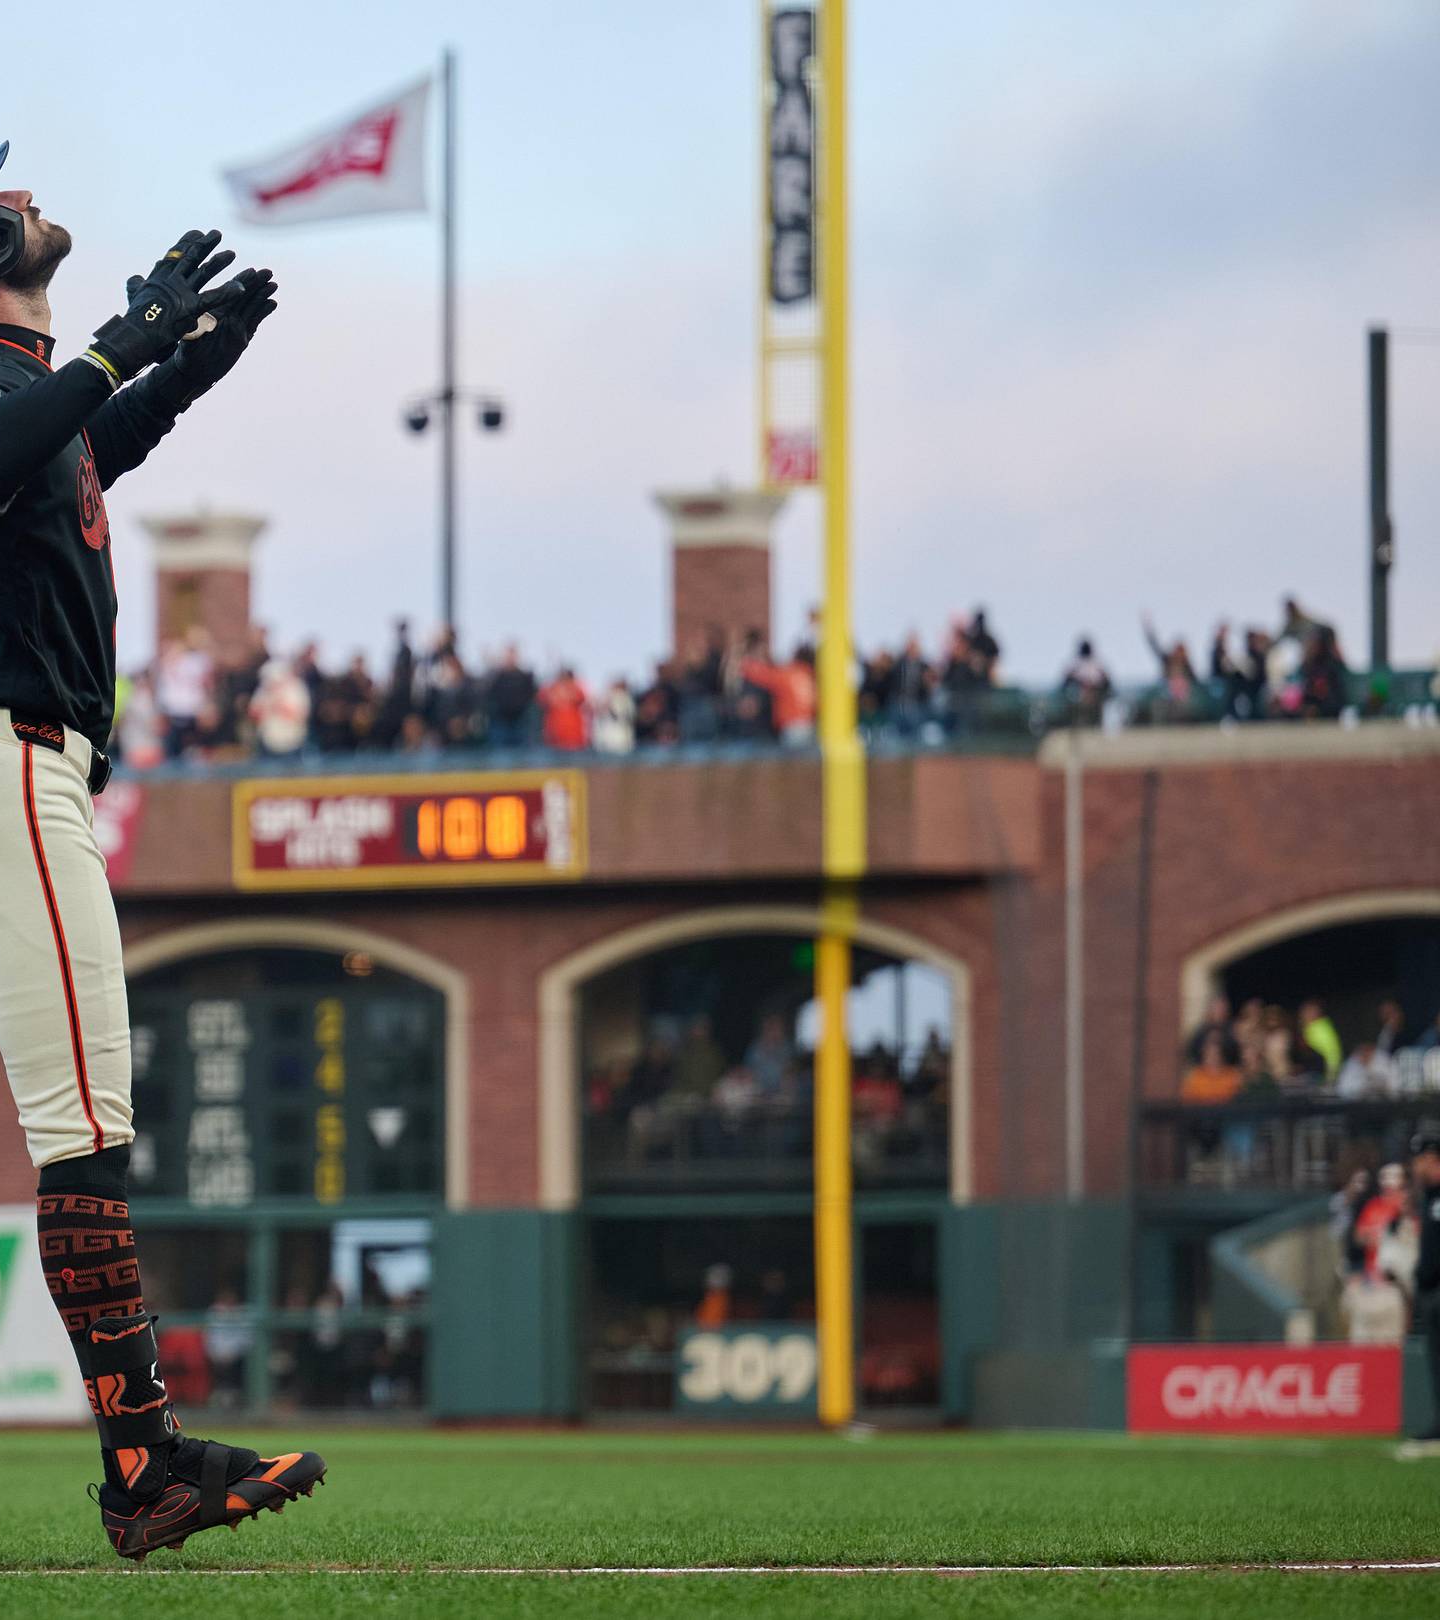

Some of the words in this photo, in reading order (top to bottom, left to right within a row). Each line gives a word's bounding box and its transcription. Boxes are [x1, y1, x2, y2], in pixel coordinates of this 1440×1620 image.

[251, 797, 394, 842] SPLASH
[681, 1334, 815, 1402] 309
[1163, 1364, 1362, 1418] ORACLE
